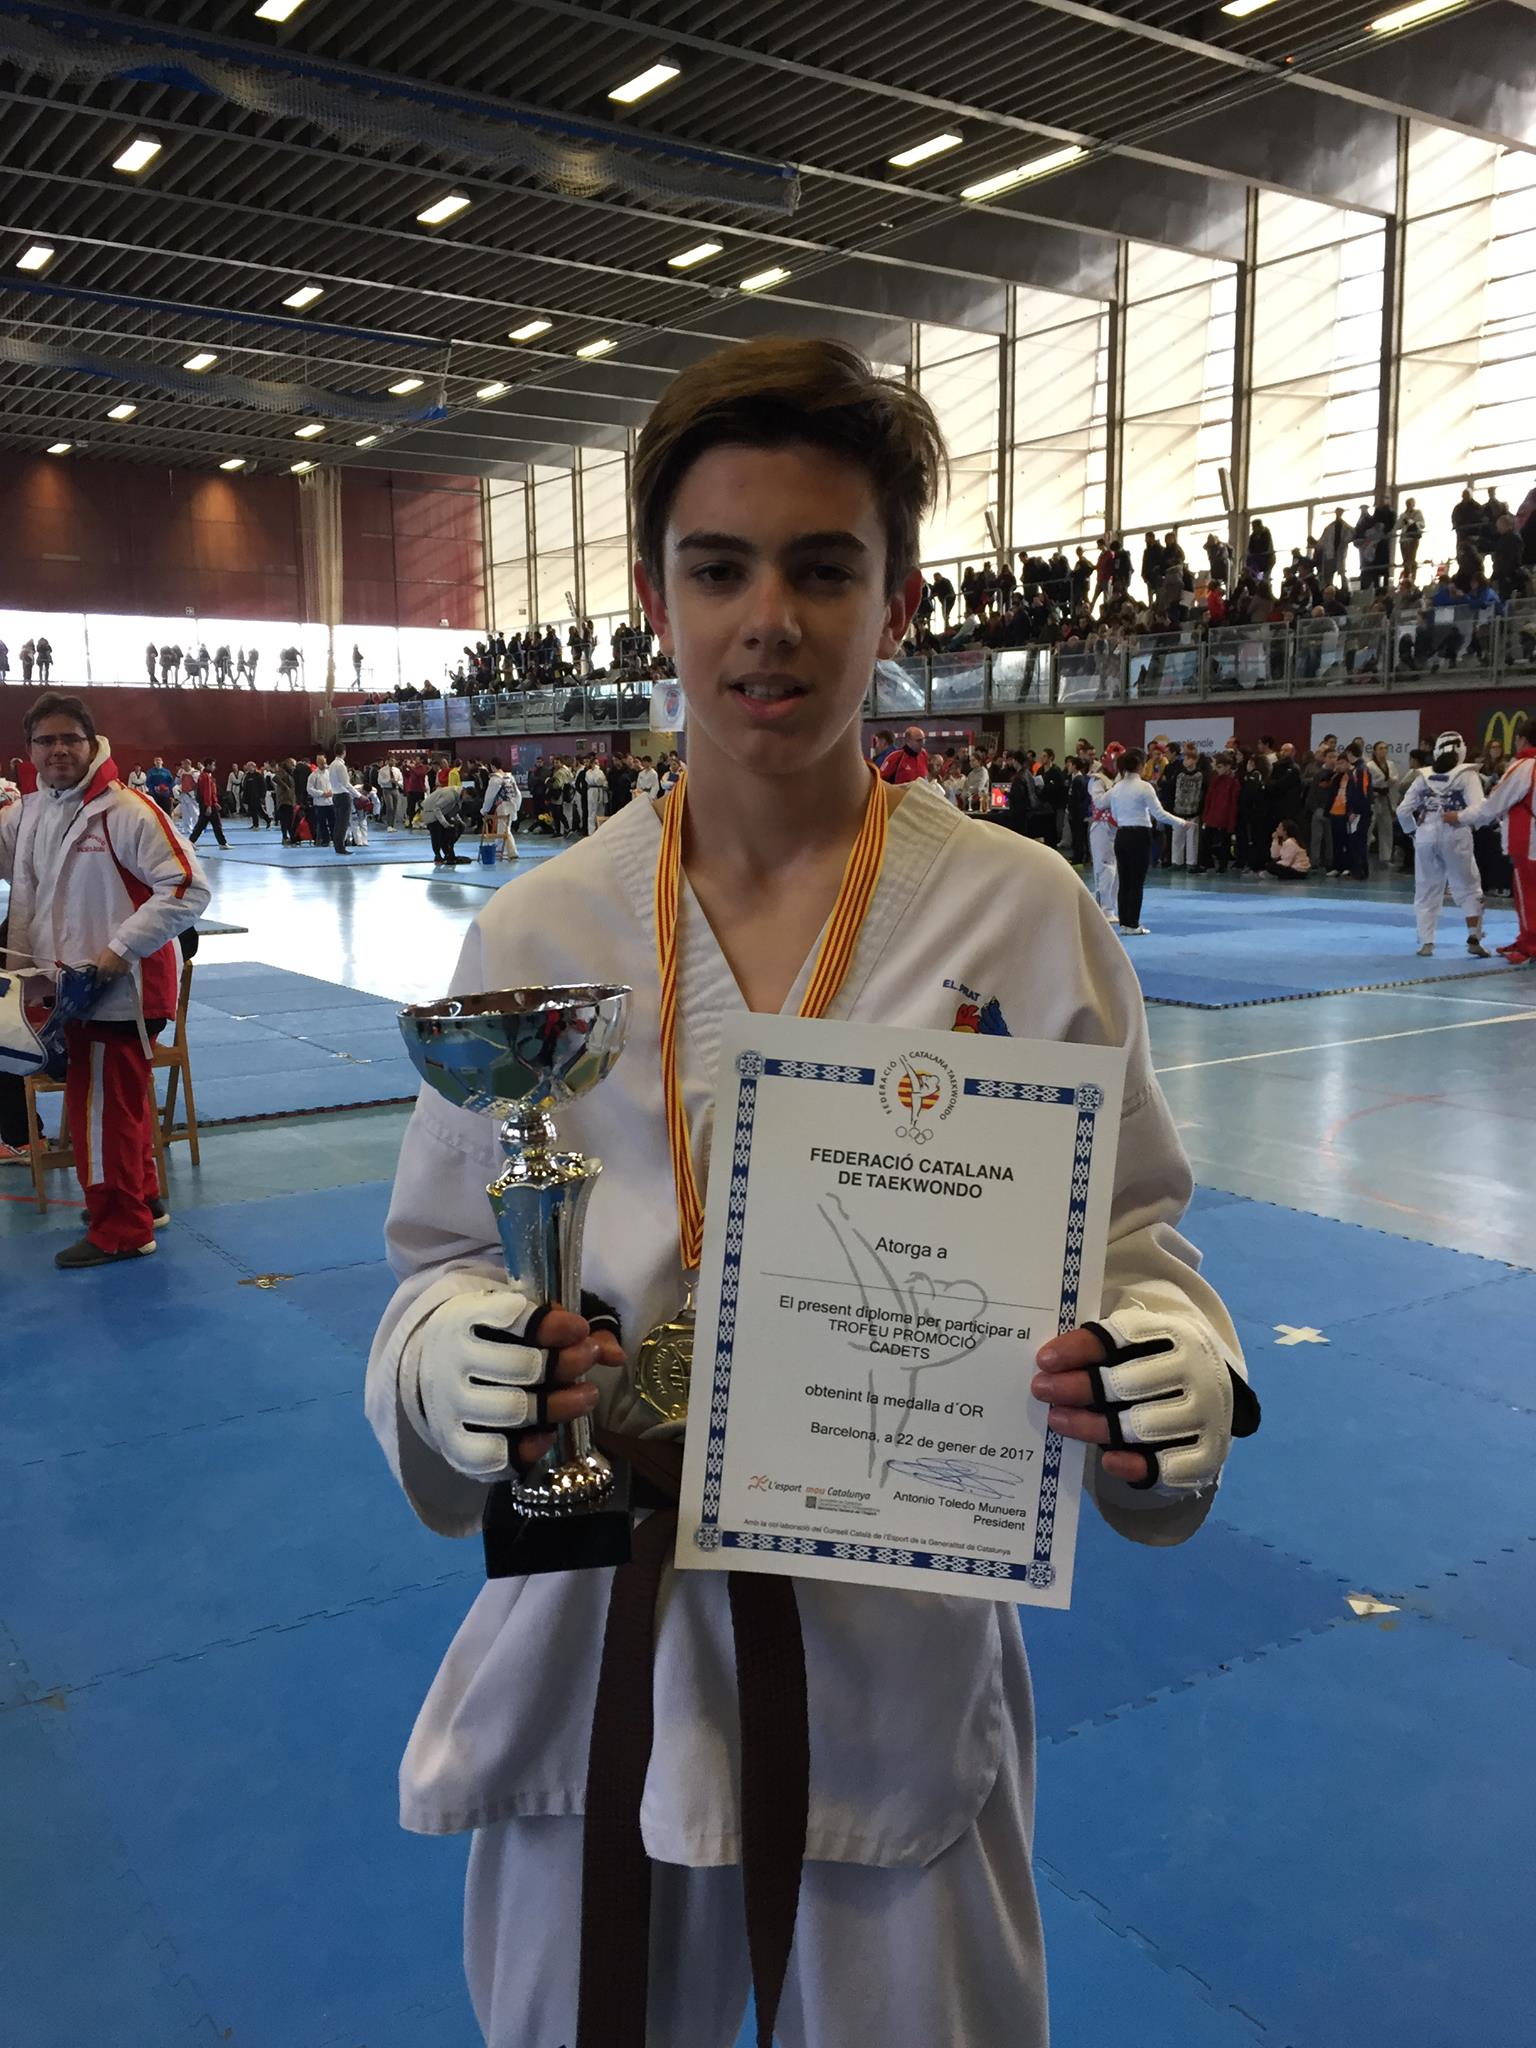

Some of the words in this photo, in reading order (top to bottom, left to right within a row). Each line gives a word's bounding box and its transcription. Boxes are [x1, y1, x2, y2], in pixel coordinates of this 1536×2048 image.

[943, 979, 959, 990] EL
[959, 983, 981, 1002] PRAT
[909, 1051, 948, 1070] CATALANA
[939, 1069, 959, 1121] TAEKWONDO
[810, 1147, 914, 1172] FEDERACIÓ
[918, 1158, 1015, 1182] CATALANA
[838, 1170, 863, 1187] DE
[866, 1173, 983, 1199] TAEKWONDO
[874, 1236, 931, 1260] Atorga
[936, 1246, 948, 1260] a
[779, 1295, 794, 1309] El
[797, 1299, 852, 1317] present
[855, 1305, 913, 1325] diploma
[916, 1314, 942, 1329] per
[944, 1319, 1014, 1338] participar
[1016, 1327, 1031, 1340] al
[828, 1318, 889, 1338] TROFEU
[892, 1327, 977, 1350] PROMOCIÓ
[869, 1340, 931, 1360] CADETS
[804, 1384, 863, 1403] obtenint
[866, 1391, 879, 1405] la
[883, 1395, 940, 1413] medalla
[810, 1421, 880, 1443] Barcelona,
[884, 1433, 893, 1443] a
[896, 1432, 914, 1446] 22
[916, 1436, 934, 1449] de
[937, 1440, 977, 1454] gener
[979, 1444, 997, 1457] de
[999, 1446, 1034, 1462] 2017
[827, 1486, 871, 1502] Catalunya
[893, 1491, 936, 1506] Antonio
[938, 1496, 976, 1511] Toledo
[978, 1502, 1027, 1518] Munuera
[973, 1514, 1026, 1532] President
[823, 1527, 849, 1536] Consell
[928, 1538, 966, 1550] Generalitat
[976, 1544, 1012, 1556] Catalunya
